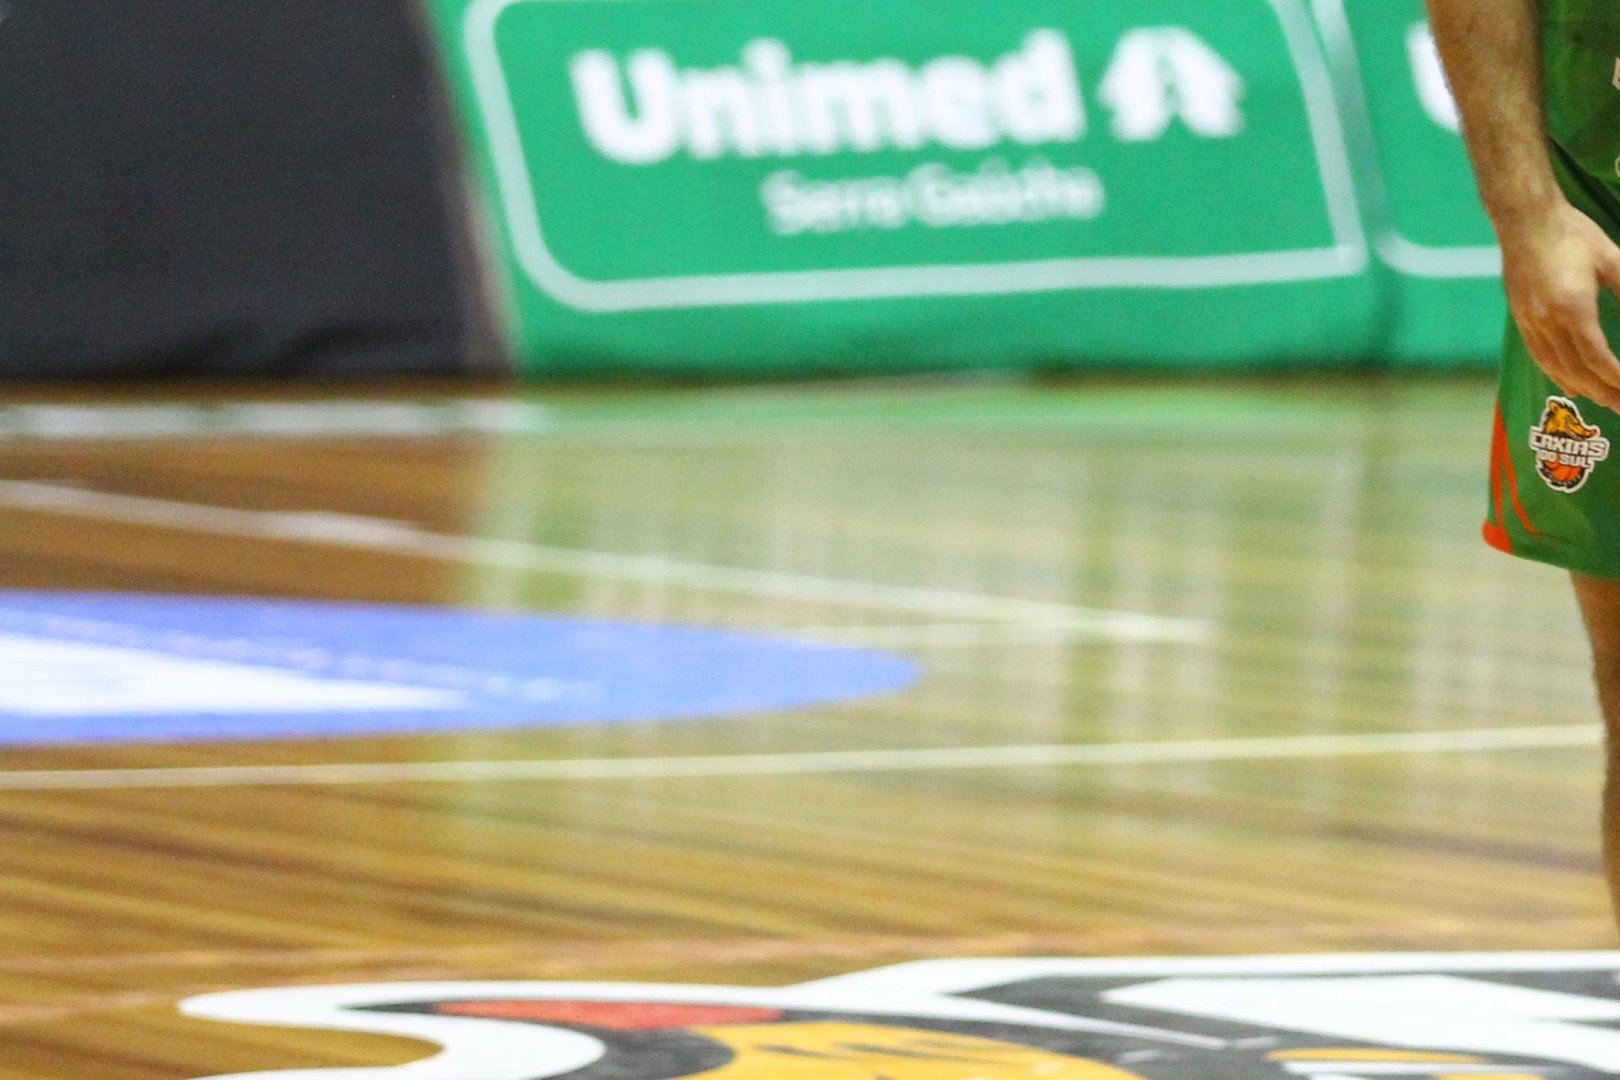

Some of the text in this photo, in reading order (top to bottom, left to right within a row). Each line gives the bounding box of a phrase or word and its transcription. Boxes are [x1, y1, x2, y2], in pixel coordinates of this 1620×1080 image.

[570, 28, 1086, 163] Unimed
[1530, 431, 1606, 457] CAXIAS
[1561, 454, 1590, 469] SUL
